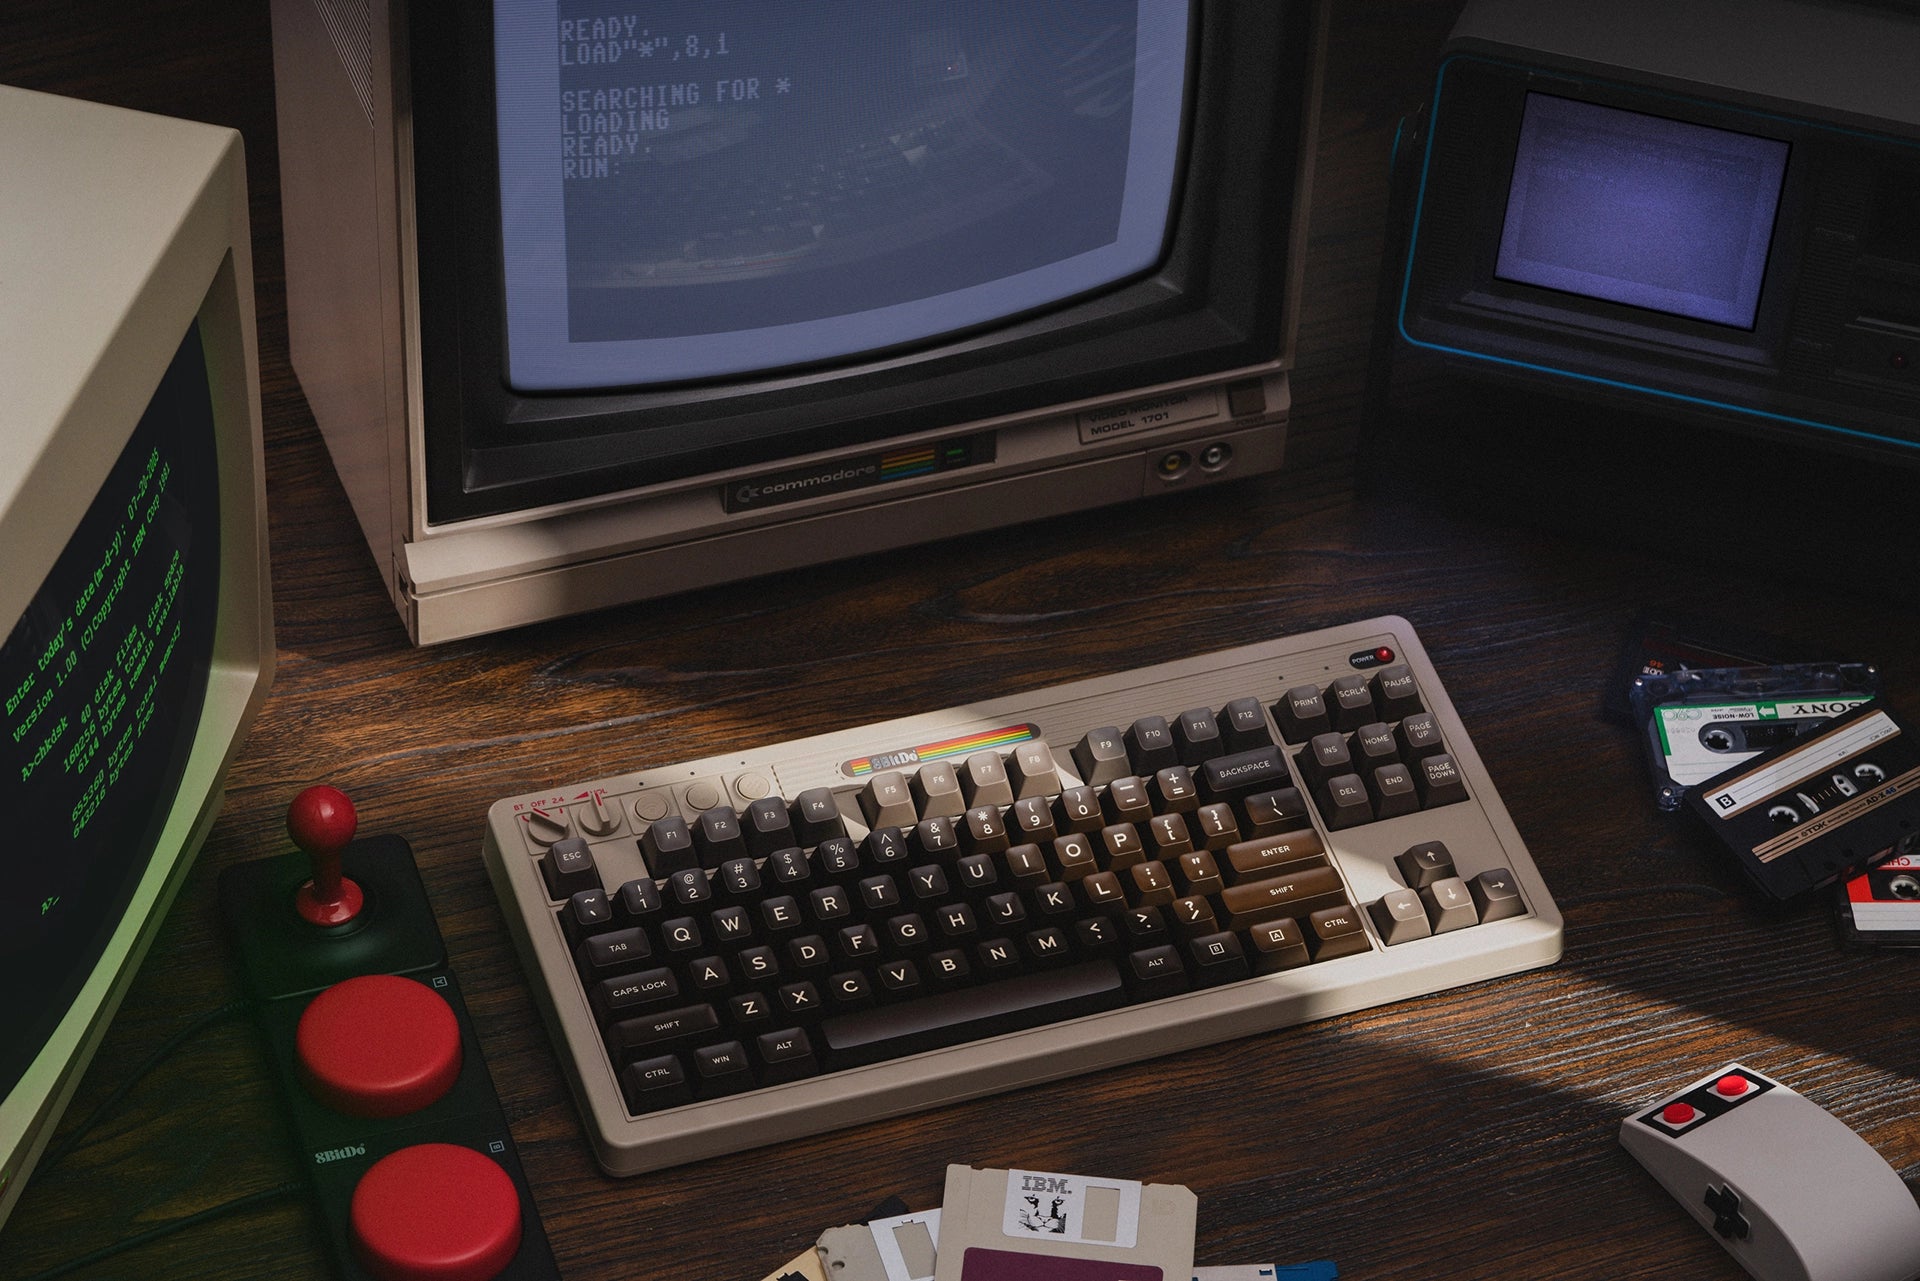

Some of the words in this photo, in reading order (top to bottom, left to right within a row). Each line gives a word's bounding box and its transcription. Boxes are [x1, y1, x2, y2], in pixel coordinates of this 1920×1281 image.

[561, 15, 649, 41] READY.
[562, 83, 700, 112] SEARCHING
[716, 78, 760, 102] FOR
[563, 109, 669, 135] LOADING
[563, 134, 650, 157] READY.
[1091, 421, 1135, 435] MODEL
[1141, 412, 1170, 424] 1701
[762, 464, 877, 495] commodore
[12, 688, 54, 743] Version
[56, 650, 78, 688] 1.00
[131, 522, 147, 557] IBM
[146, 494, 160, 523] Corp
[63, 721, 97, 773] 160256
[97, 678, 123, 721] bytes
[124, 632, 147, 674] total
[147, 592, 163, 629] disk
[163, 549, 180, 590] space
[1352, 655, 1374, 664] POWER
[5, 672, 36, 716] Enter
[37, 616, 74, 672] today's
[76, 737, 100, 774] 6144
[101, 693, 127, 737] bytes
[128, 639, 155, 690] remain
[154, 564, 185, 635] available
[80, 703, 92, 725] 40
[94, 669, 115, 705] disk
[115, 624, 138, 668] files
[1384, 676, 1412, 688] PAUSE
[1338, 686, 1366, 698] SCRLK
[1294, 696, 1319, 708] PRINT
[1238, 711, 1254, 720] F12
[107, 723, 133, 769] bytes
[135, 675, 158, 720] total
[1192, 721, 1206, 730] F11
[1409, 721, 1432, 732] PAGE
[1145, 730, 1161, 739] F10
[1364, 734, 1390, 745] HOME
[1418, 730, 1429, 739] UP
[1100, 740, 1112, 749] F9
[1323, 746, 1338, 755] INS
[109, 741, 135, 786] bytes
[1028, 755, 1041, 764] F8
[980, 764, 992, 774] F7
[1219, 760, 1271, 778] BACKSPACE
[1428, 762, 1451, 773] PAGE
[932, 775, 945, 784] F6
[1168, 773, 1180, 784] +
[1430, 769, 1456, 780] DOWN
[1385, 776, 1403, 786] END
[590, 788, 608, 796] OL
[884, 786, 897, 795] F5
[1173, 786, 1184, 794] =
[1340, 787, 1357, 796] DEL
[513, 803, 525, 812] BT
[530, 799, 547, 808] OFF
[812, 801, 825, 811] F4
[1078, 804, 1088, 816] 0
[764, 811, 776, 820] F3
[1030, 815, 1040, 826] 9
[714, 820, 727, 830] F2
[930, 822, 940, 833] &
[984, 823, 993, 835] 8
[1806, 820, 1828, 836] TDK
[666, 830, 678, 839] F1
[880, 834, 892, 844] ^
[1113, 833, 1127, 848] P
[933, 835, 942, 847] 7
[830, 843, 844, 855] %
[885, 846, 895, 858] 6
[1066, 844, 1081, 858] O
[1261, 845, 1290, 857] ENTER
[562, 852, 582, 861] ESC
[784, 854, 792, 864] $
[836, 857, 845, 868] 5
[1021, 854, 1030, 868] I
[734, 864, 744, 874] #
[788, 866, 798, 876] 4
[970, 864, 984, 878] U
[684, 874, 694, 884] @
[738, 878, 748, 888] 3
[920, 874, 934, 889] Y
[637, 884, 642, 896] !
[688, 888, 698, 899] 2
[871, 884, 885, 900] T
[1096, 882, 1110, 896] L
[1269, 884, 1294, 896] SHIFT
[640, 898, 647, 908] 1
[822, 896, 838, 912] R
[1046, 892, 1064, 906] K
[1001, 903, 1013, 916] J
[1184, 901, 1194, 911] ?
[773, 906, 789, 922] E
[949, 913, 966, 927] H
[721, 916, 740, 932] W
[1324, 917, 1348, 928] CTRL
[674, 927, 691, 942] Q
[901, 924, 916, 938] G
[609, 943, 628, 952] TAB
[850, 935, 864, 950] F
[1038, 936, 1057, 950] M
[800, 946, 816, 960] D
[990, 946, 1007, 960] N
[752, 956, 767, 970] S
[941, 958, 956, 972] B
[1148, 958, 1164, 968] ALT
[704, 967, 718, 980] A
[890, 968, 905, 982] V
[612, 985, 639, 997] CAPS
[642, 980, 668, 992] LOCK
[842, 980, 858, 992] C
[792, 990, 808, 1004] X
[742, 1002, 758, 1015] Z
[654, 1020, 680, 1032] SHIFT
[776, 1040, 793, 1050] ALT
[712, 1055, 730, 1064] WIN
[644, 1068, 670, 1079] CTRL
[314, 1143, 367, 1164] 8BitDo
